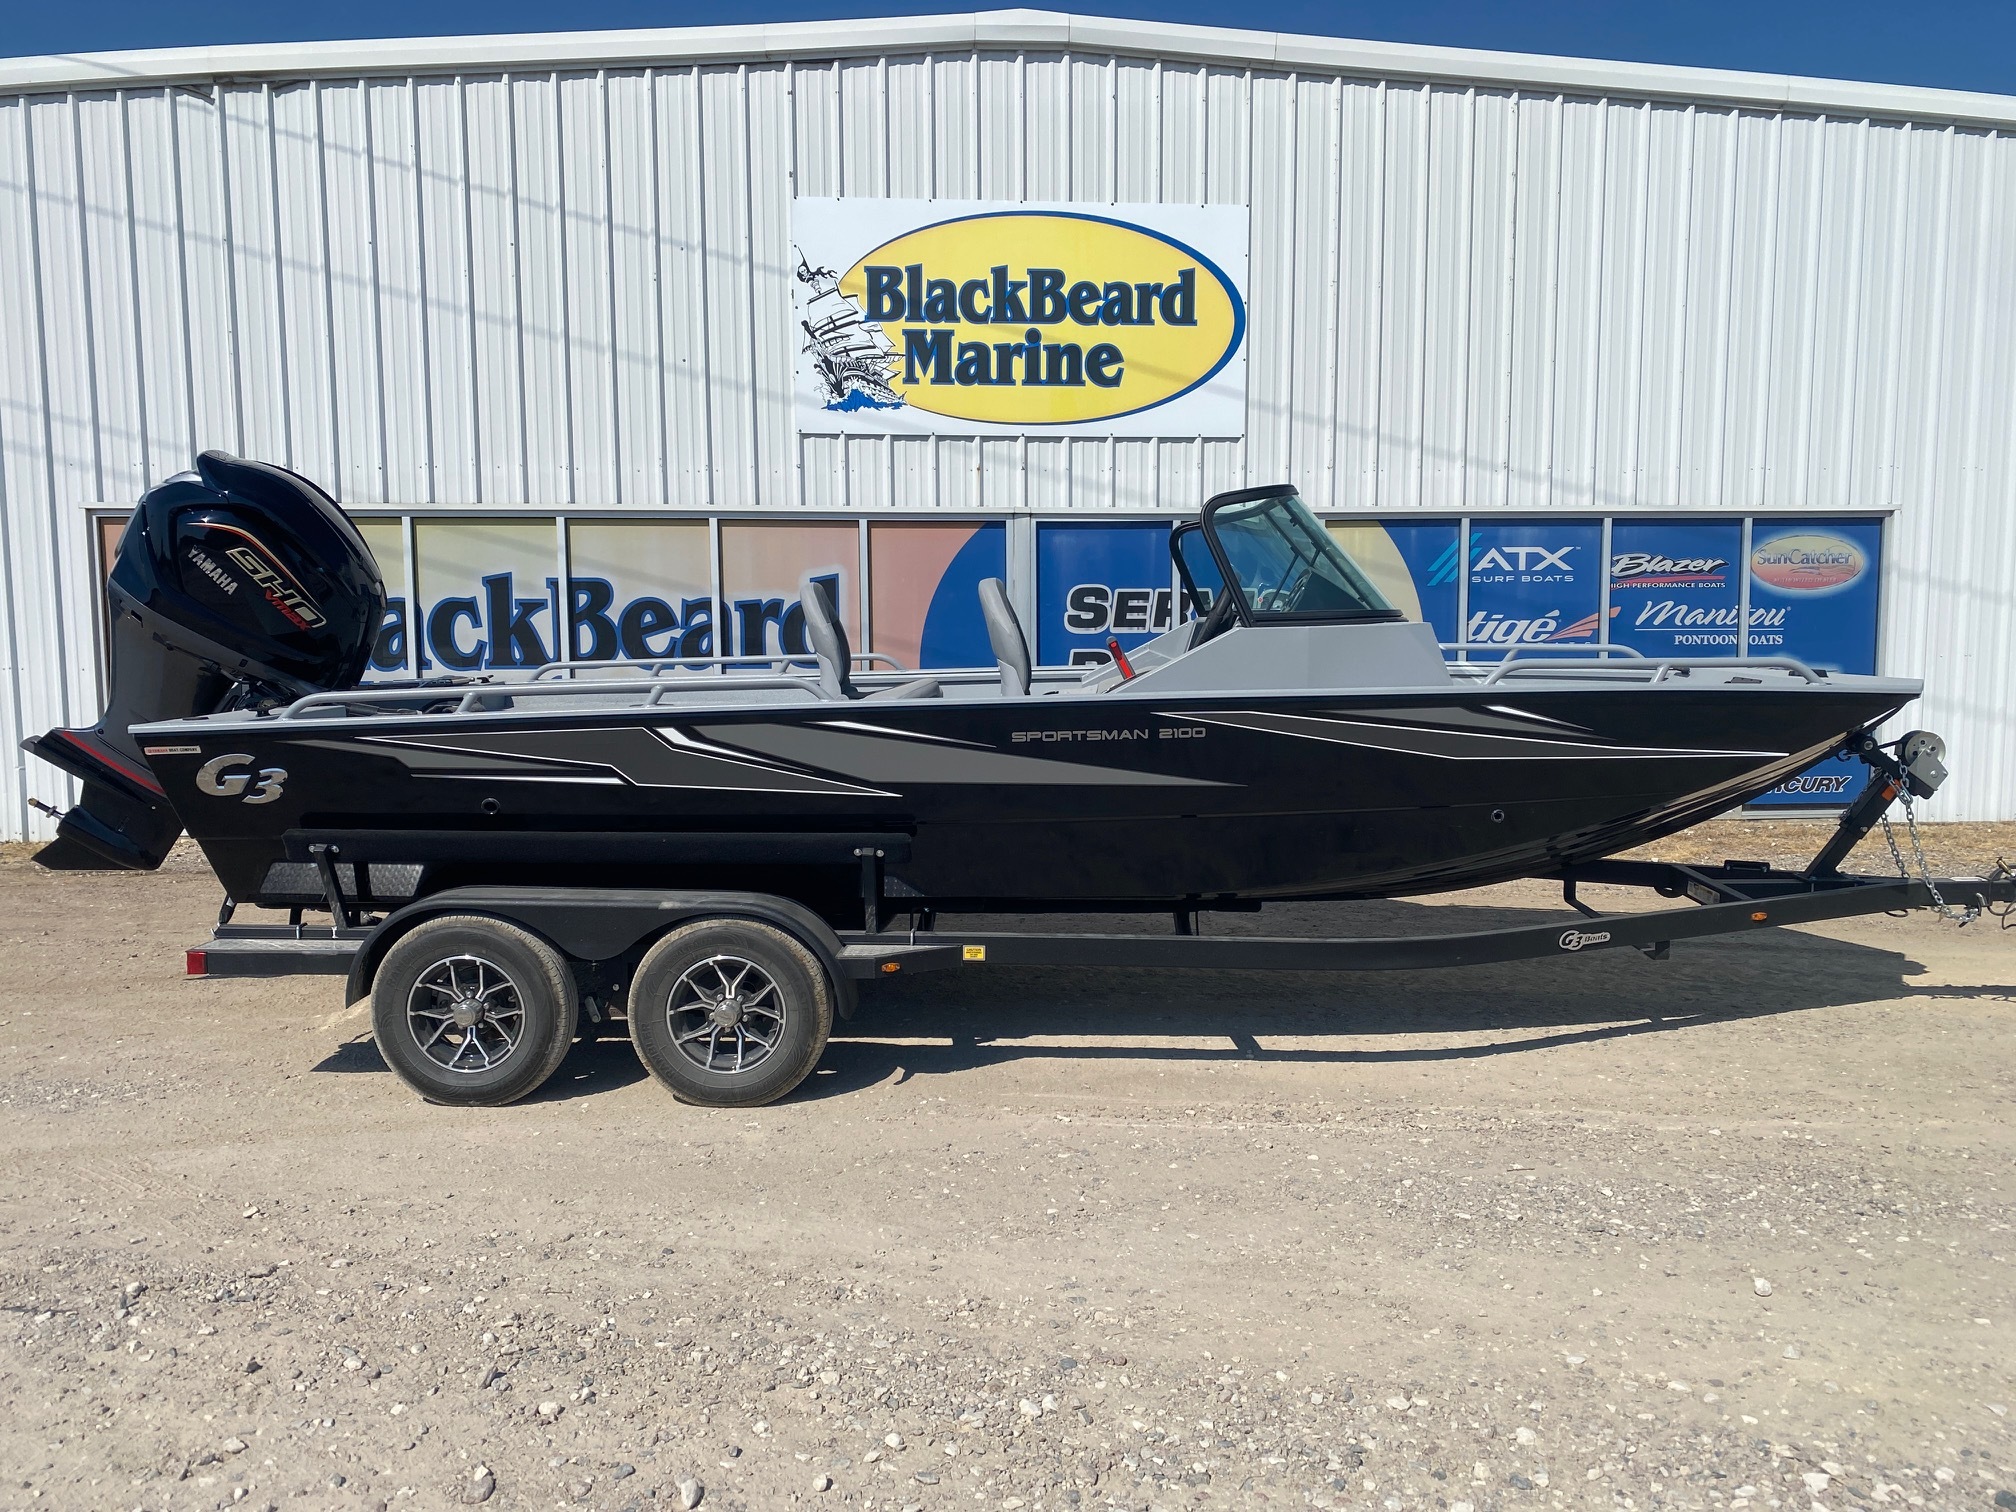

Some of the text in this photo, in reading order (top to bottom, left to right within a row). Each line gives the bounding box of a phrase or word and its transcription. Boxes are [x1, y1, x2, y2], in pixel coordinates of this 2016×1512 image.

[864, 263, 1198, 326] BlackBeard
[902, 327, 1125, 388] Marine
[1472, 546, 1575, 571] ATX
[1611, 553, 1728, 578] Blazer
[1757, 548, 1852, 565] SunCatcher
[188, 545, 238, 595] YAMAHA
[225, 547, 327, 628] SHO
[366, 572, 839, 672] ackBeard
[1635, 600, 1786, 626] Maniou
[1674, 634, 1783, 645] PONTOON OATS
[1012, 727, 1206, 743] SPORTSMAN 2100
[196, 753, 288, 804] G3
[1767, 776, 1853, 794] CURY
[1560, 931, 1583, 949] G3
